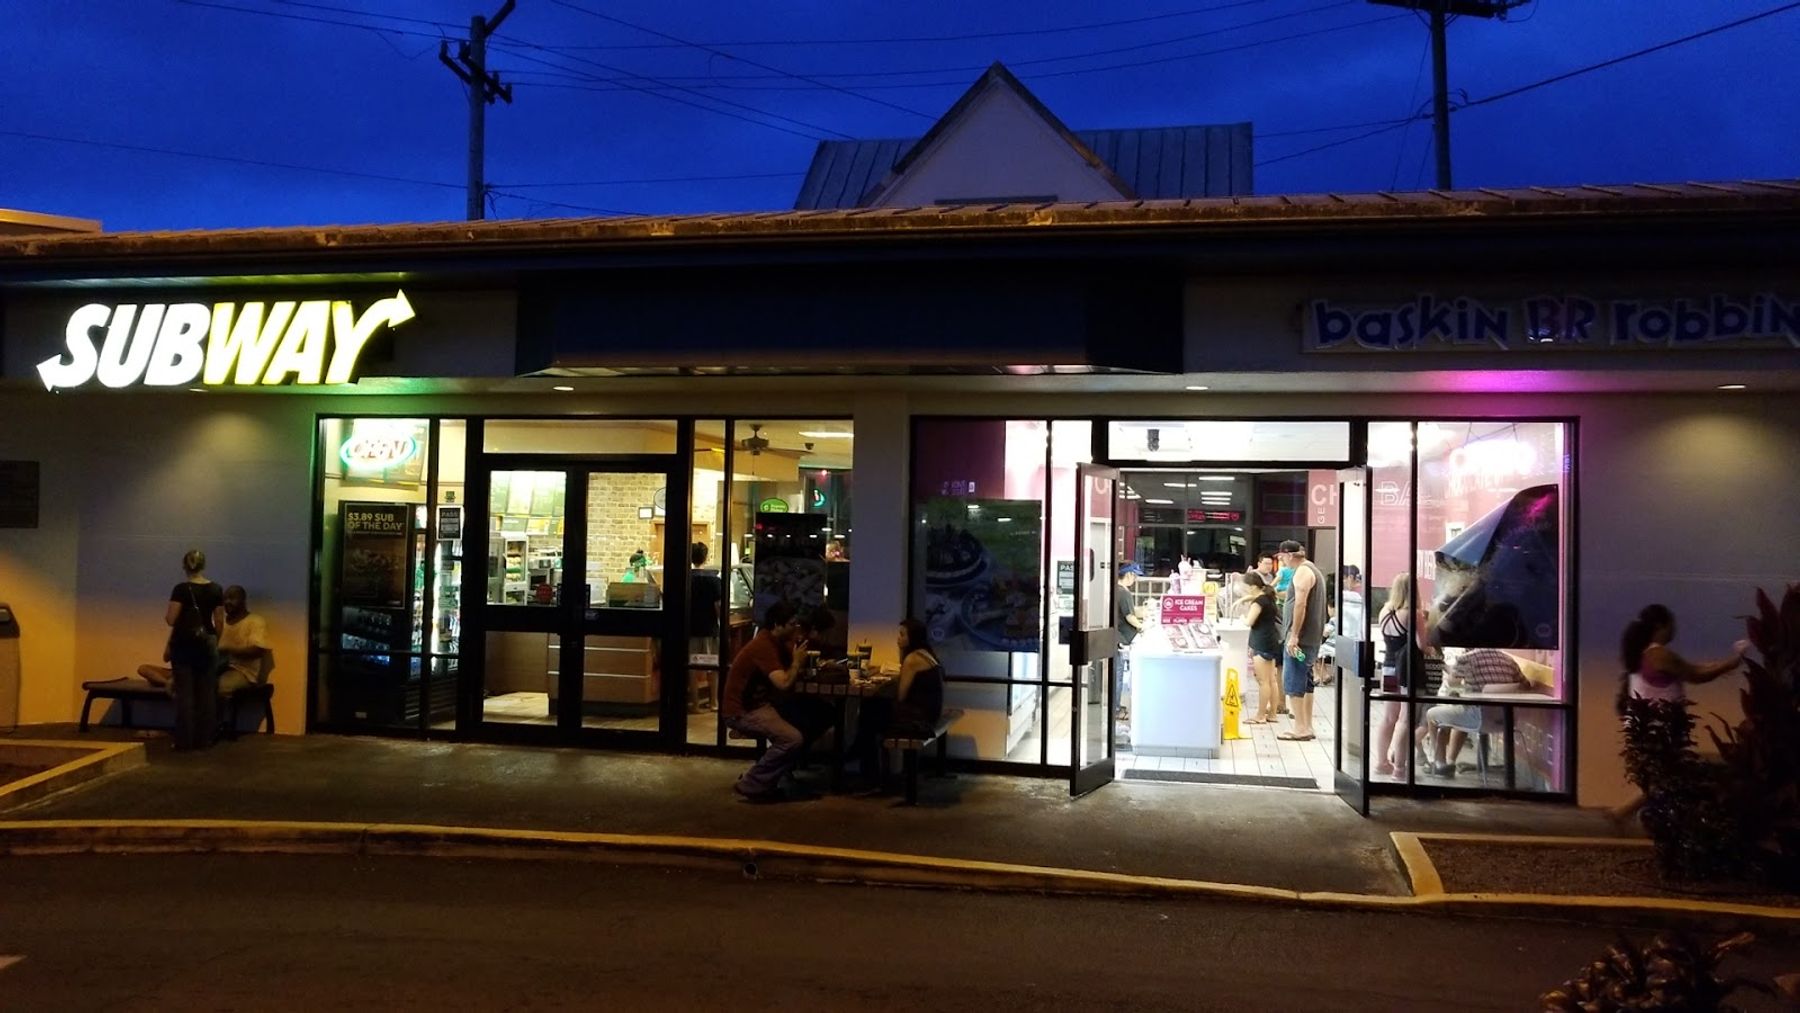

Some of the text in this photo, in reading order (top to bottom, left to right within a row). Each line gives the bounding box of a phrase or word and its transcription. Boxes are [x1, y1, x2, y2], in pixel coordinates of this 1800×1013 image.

[1526, 296, 1596, 343] BR
[37, 289, 415, 391] SUBWAY
[347, 512, 394, 522] $3.89 SUB
[347, 521, 402, 531] OF THE DAY
